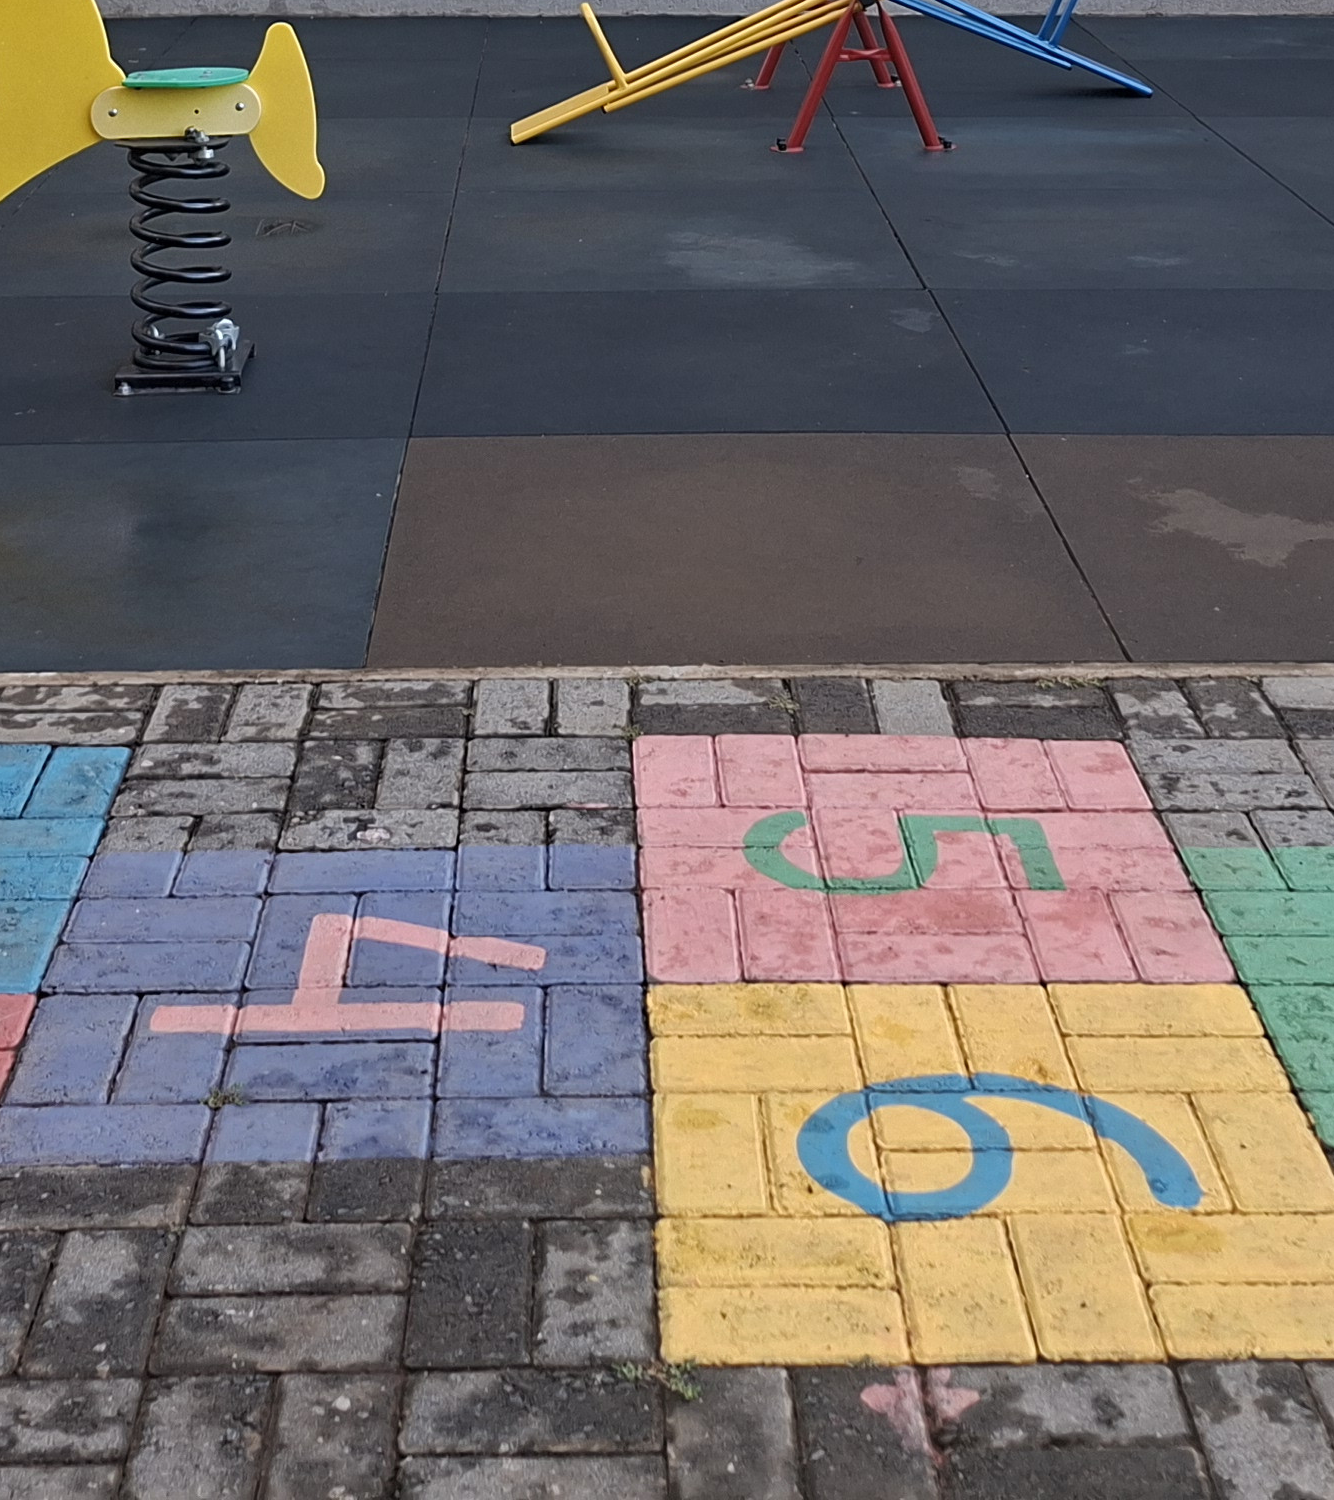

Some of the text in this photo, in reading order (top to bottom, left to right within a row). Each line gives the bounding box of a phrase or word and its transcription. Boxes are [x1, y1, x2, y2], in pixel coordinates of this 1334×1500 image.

[741, 810, 1066, 892] 5
[149, 911, 547, 1033] 4
[795, 1071, 1207, 1223] 6
